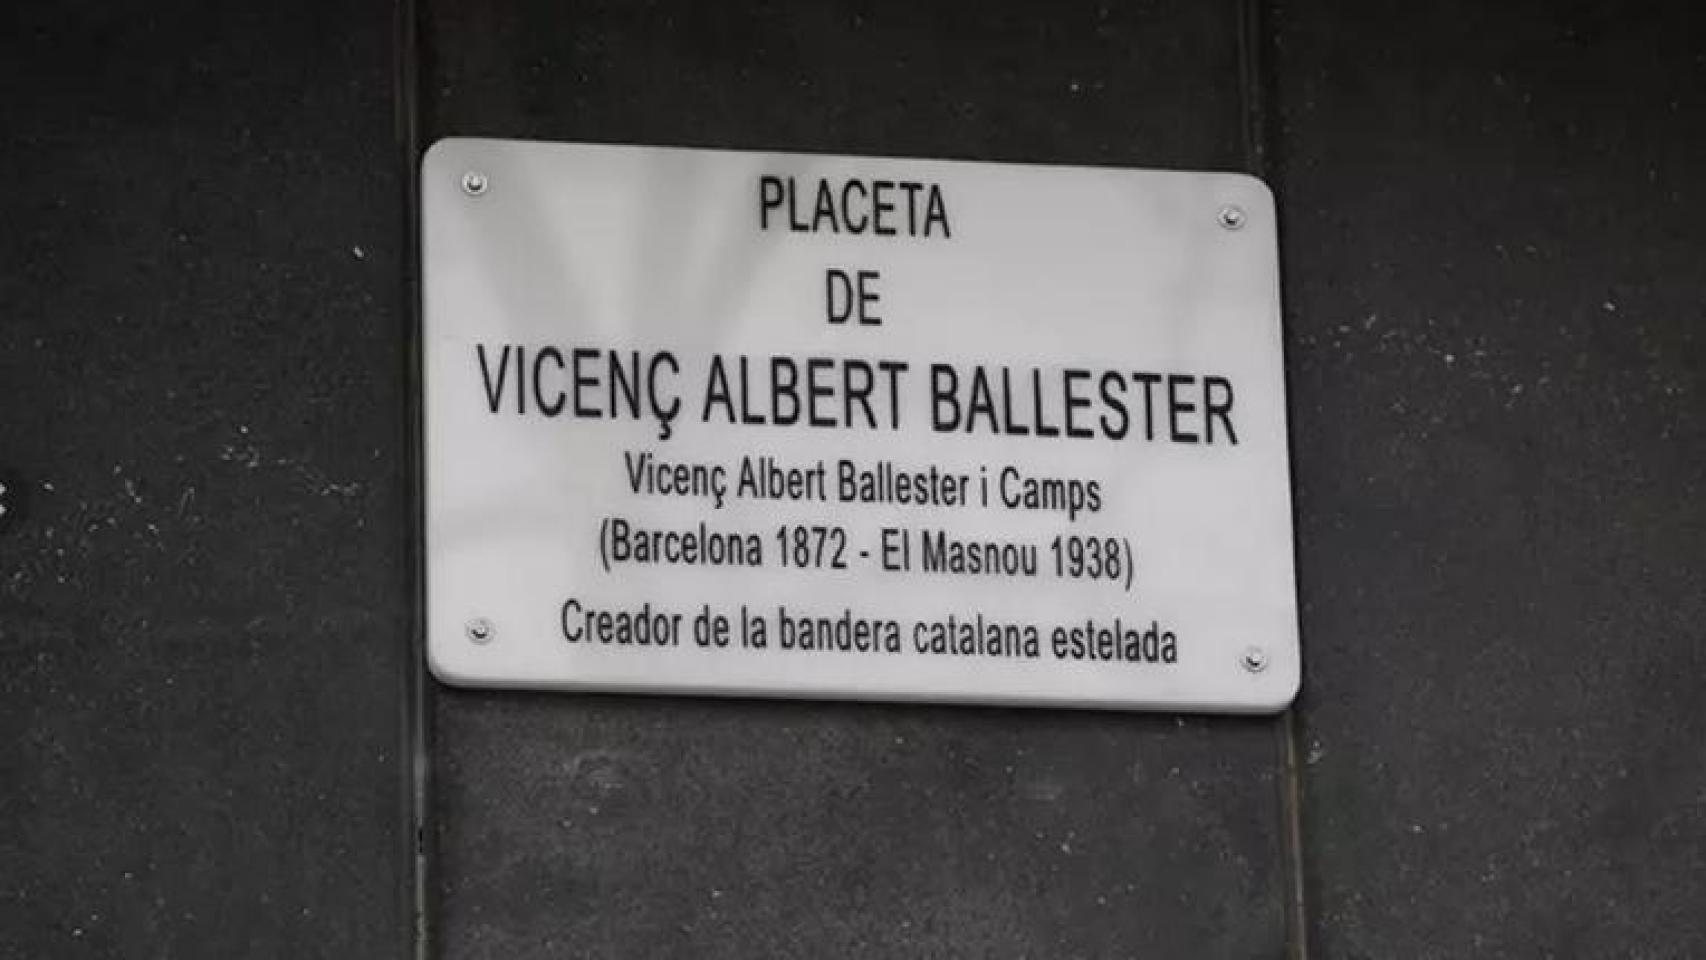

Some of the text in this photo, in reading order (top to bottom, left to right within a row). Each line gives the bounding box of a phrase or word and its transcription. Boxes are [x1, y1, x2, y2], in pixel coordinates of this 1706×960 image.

[759, 175, 950, 239] PLACETA
[825, 269, 883, 327] DE
[477, 343, 1239, 446] VICENÇ ALBERT BALLESTER
[624, 450, 1102, 522] Vicenç Albert Ballester i Camps
[600, 517, 1133, 590] (Barcelona 1872 - El Masnou 1938)
[562, 598, 1178, 664] Creador de la bandera catalana estelada
